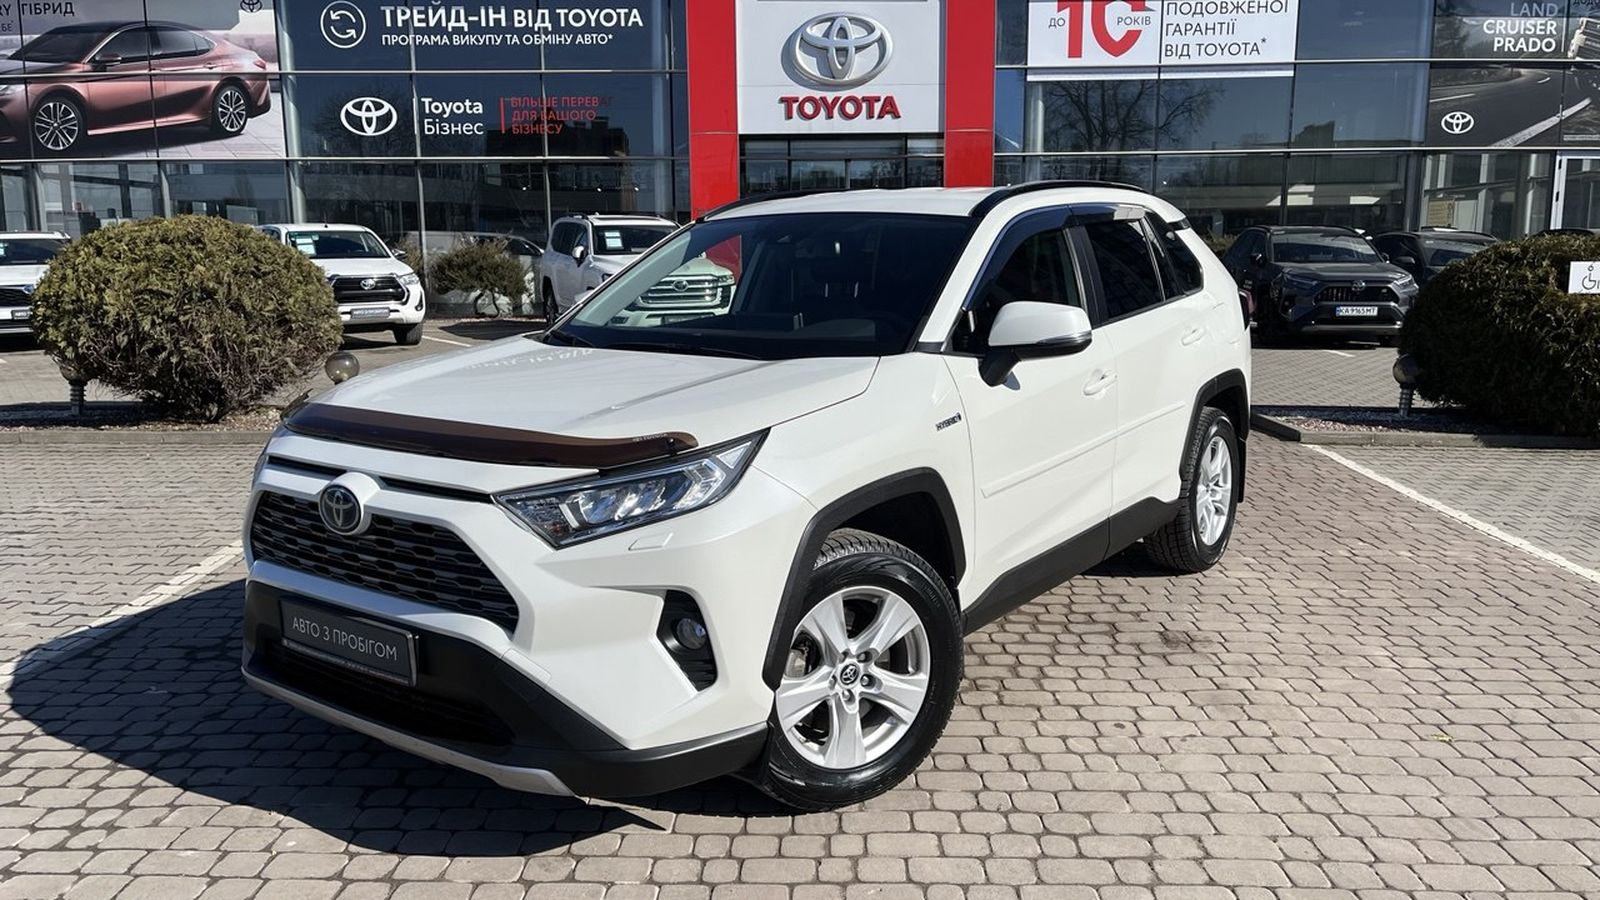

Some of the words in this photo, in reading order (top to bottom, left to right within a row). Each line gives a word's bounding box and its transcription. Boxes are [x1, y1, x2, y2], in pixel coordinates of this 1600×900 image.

[21, 2, 75, 17] ГІБРИД
[380, 0, 507, 32] ТРЕЙД-ІН
[513, 9, 552, 32] ВІД
[556, 8, 644, 27] TOYOTA
[1510, 2, 1559, 17] LAND
[1048, 17, 1066, 29] ДО
[1116, 16, 1152, 26] РОКІВ
[1165, 18, 1238, 36] ГАРАНТІЇ
[1483, 19, 1557, 35] CRUISER
[381, 34, 450, 46] ПРОГРАМА
[452, 34, 503, 46] ВИКУПУ
[505, 34, 520, 46] ТА
[522, 34, 573, 46] ОБМІНУ
[1493, 37, 1556, 52] PRADO
[1164, 44, 1191, 60] ВІД
[421, 97, 484, 118] Toyota
[511, 110, 537, 121] ДЛЯ
[780, 95, 902, 120] TOYOTA
[424, 118, 484, 135] Бізнес
[511, 123, 563, 135] БІЗНЕСУ
[292, 616, 320, 638] АВТО
[333, 629, 397, 661] ПРОБІГОМ
